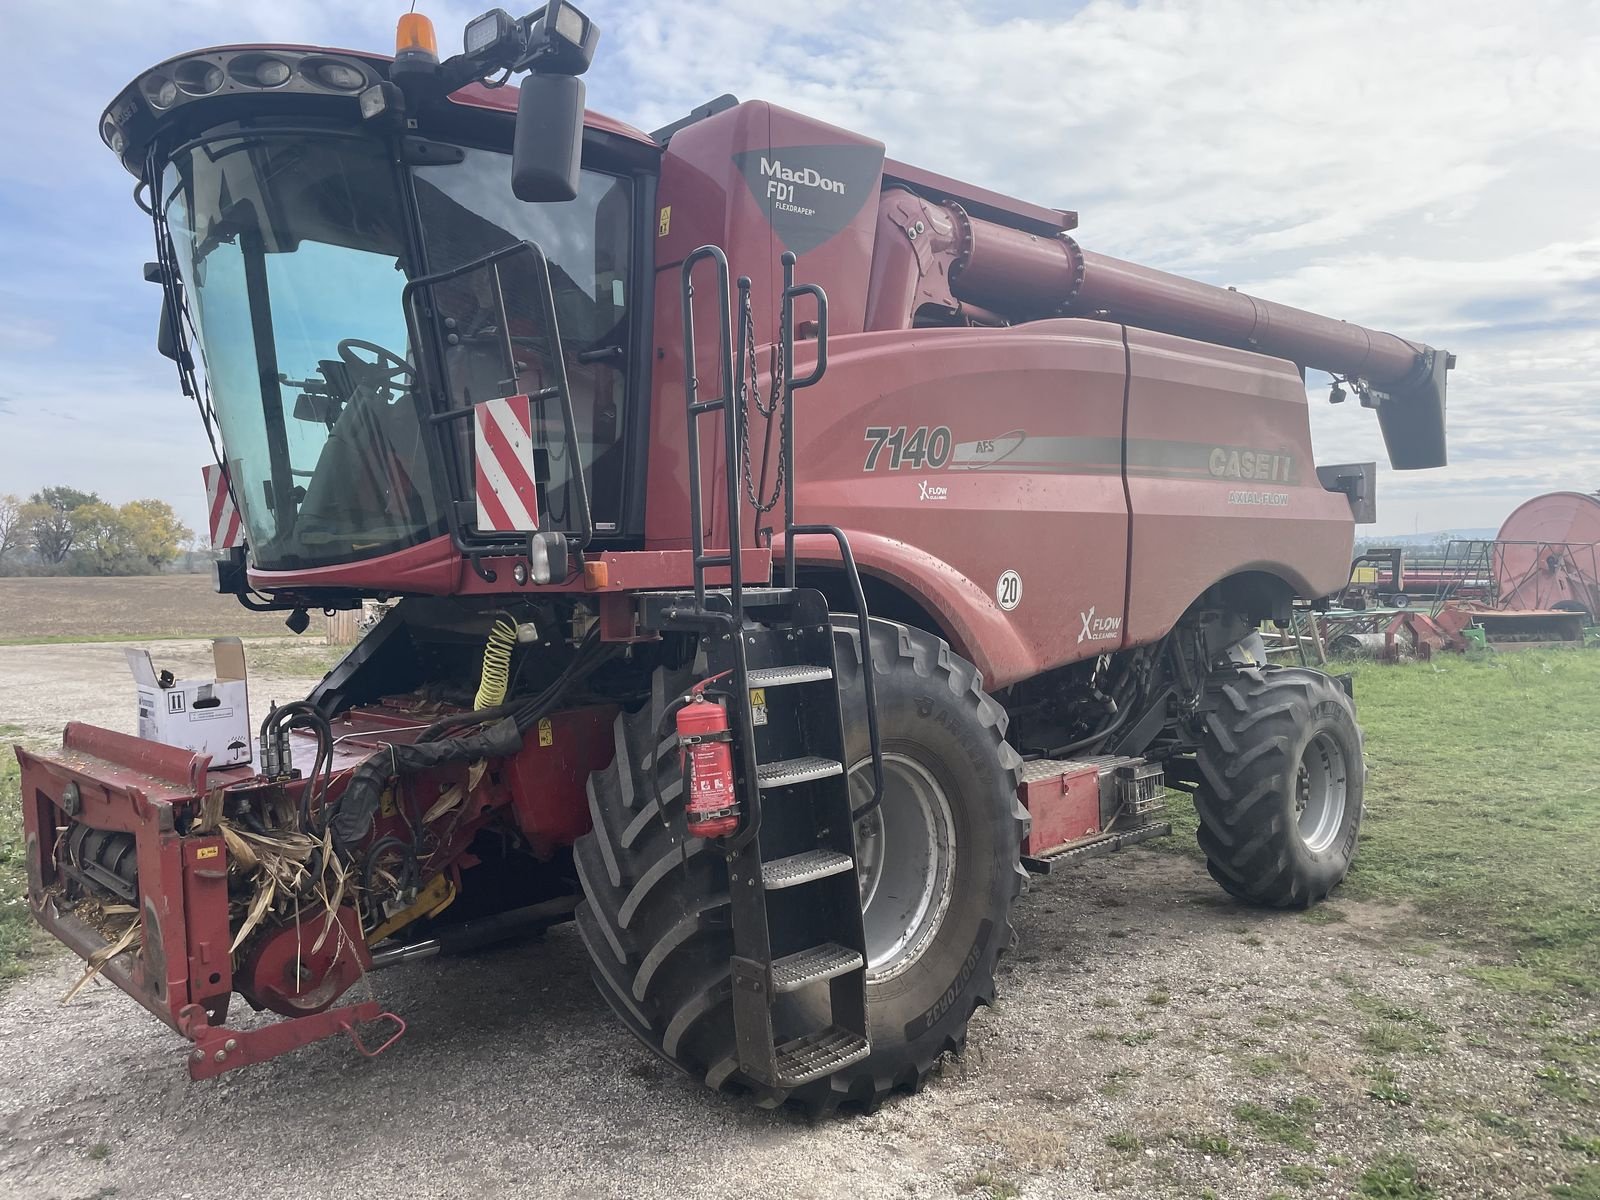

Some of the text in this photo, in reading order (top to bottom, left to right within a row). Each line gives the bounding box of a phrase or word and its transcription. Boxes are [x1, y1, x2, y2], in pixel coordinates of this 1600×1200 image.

[760, 157, 845, 195] MacDon
[766, 181, 794, 202] FD1
[863, 426, 952, 471] 7140
[975, 441, 995, 453] AFS
[1209, 448, 1270, 479] CASE
[929, 487, 948, 495] FLOW
[1001, 577, 1018, 603] 20
[1093, 617, 1121, 631] FLOW
[1092, 632, 1118, 640] CLEANING
